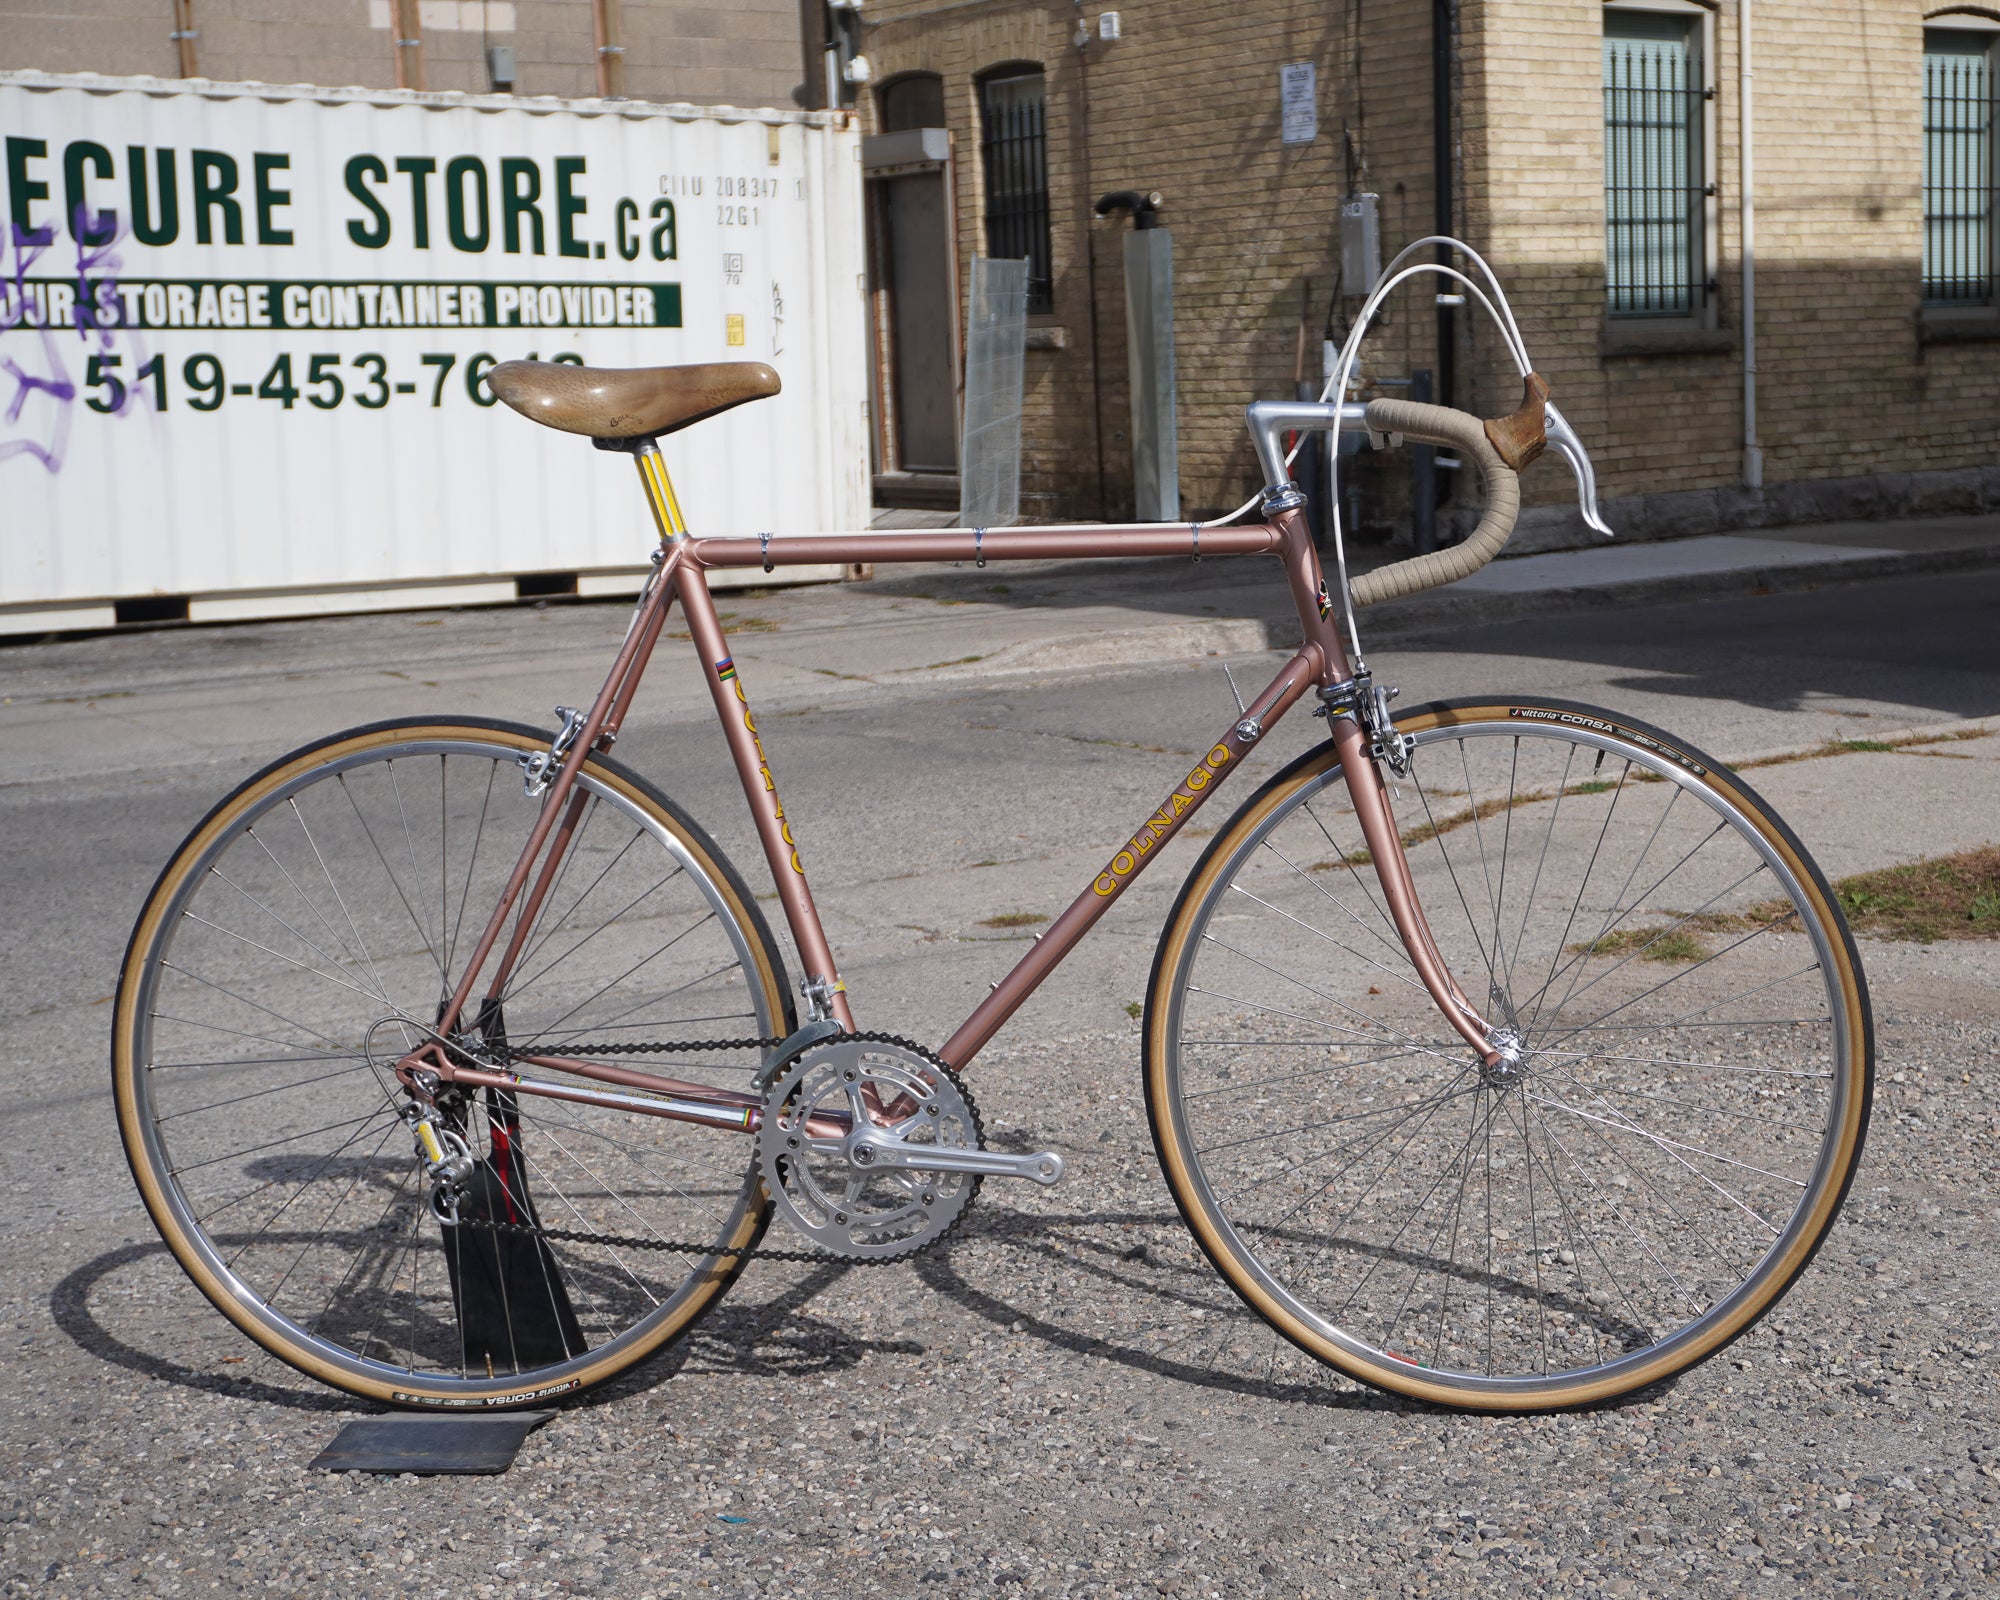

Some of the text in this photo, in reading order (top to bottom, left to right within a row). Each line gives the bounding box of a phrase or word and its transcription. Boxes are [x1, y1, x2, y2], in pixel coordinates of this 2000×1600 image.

[5, 136, 678, 262] ECURE STORE.ca
[717, 205, 759, 226] 22G1
[95, 284, 272, 327] STORAGE
[283, 284, 485, 327] CONTAINER
[496, 286, 656, 327] PROVIDER
[85, 351, 585, 414] 519-453-76
[1560, 714, 1613, 733] CORSA
[1092, 743, 1231, 897] COLNAGO
[486, 1392, 535, 1405] CORSA
